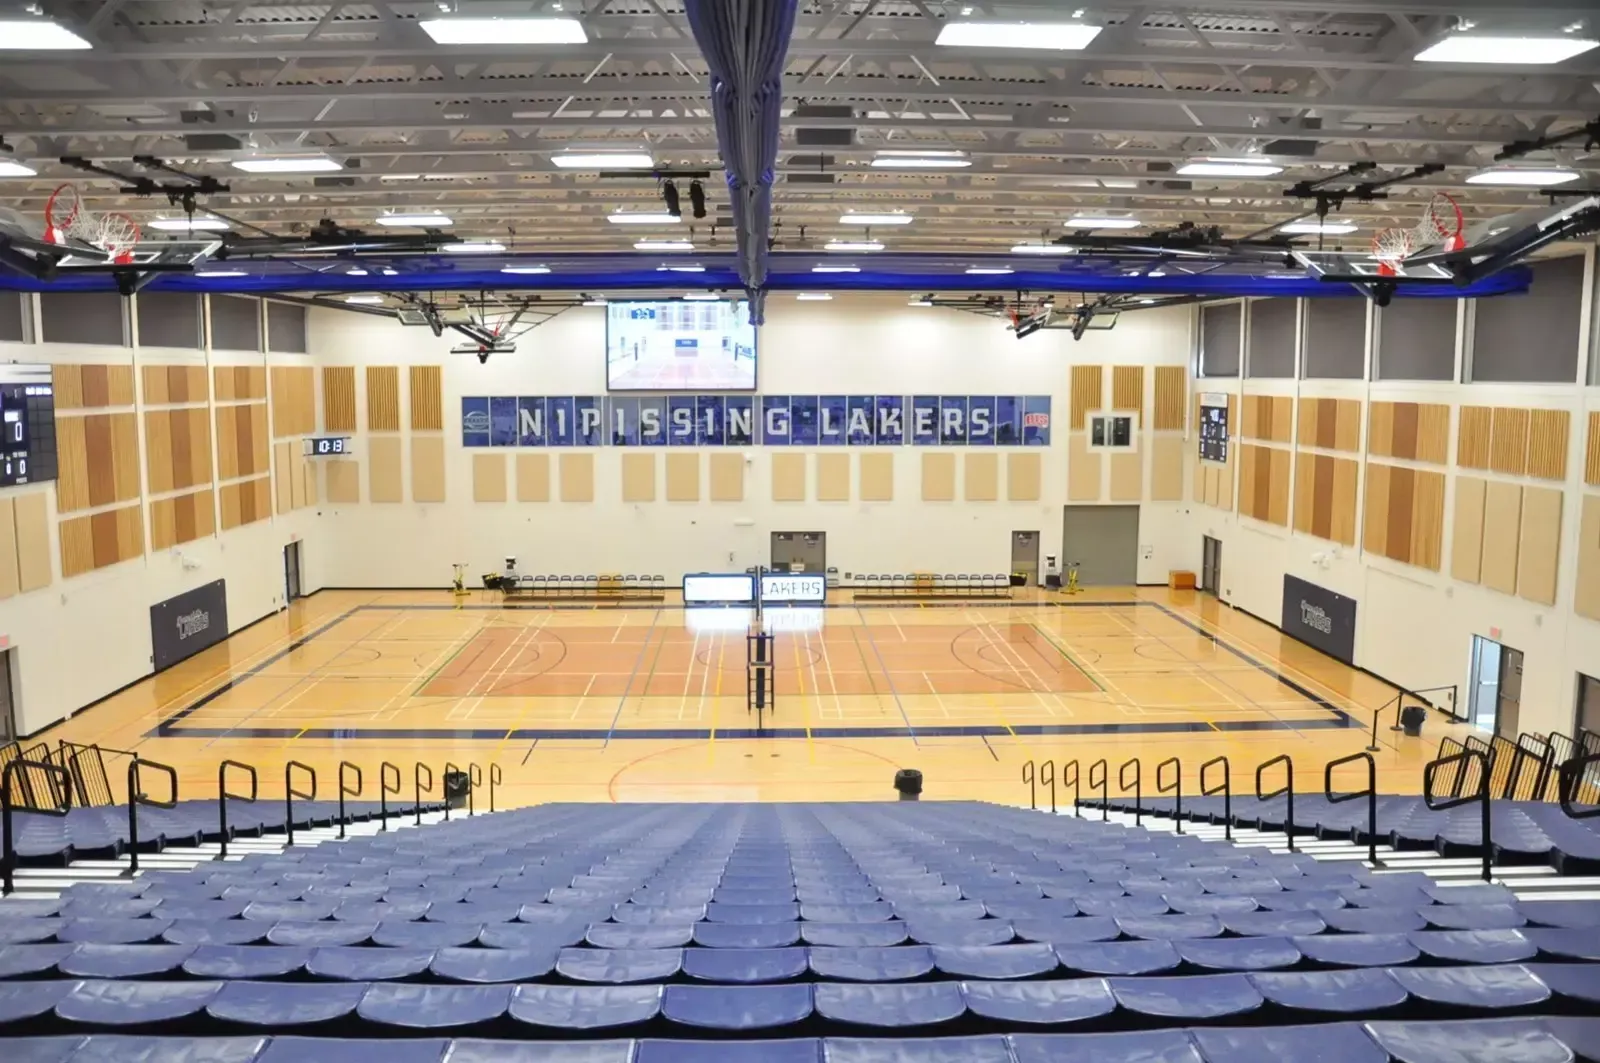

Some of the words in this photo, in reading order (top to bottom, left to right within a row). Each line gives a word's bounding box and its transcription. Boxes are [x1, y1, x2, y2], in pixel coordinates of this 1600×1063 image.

[519, 407, 790, 436] NIPISSING
[821, 407, 990, 436] LAKERS
[318, 439, 342, 453] 10:13
[761, 581, 821, 595] LAKERS
